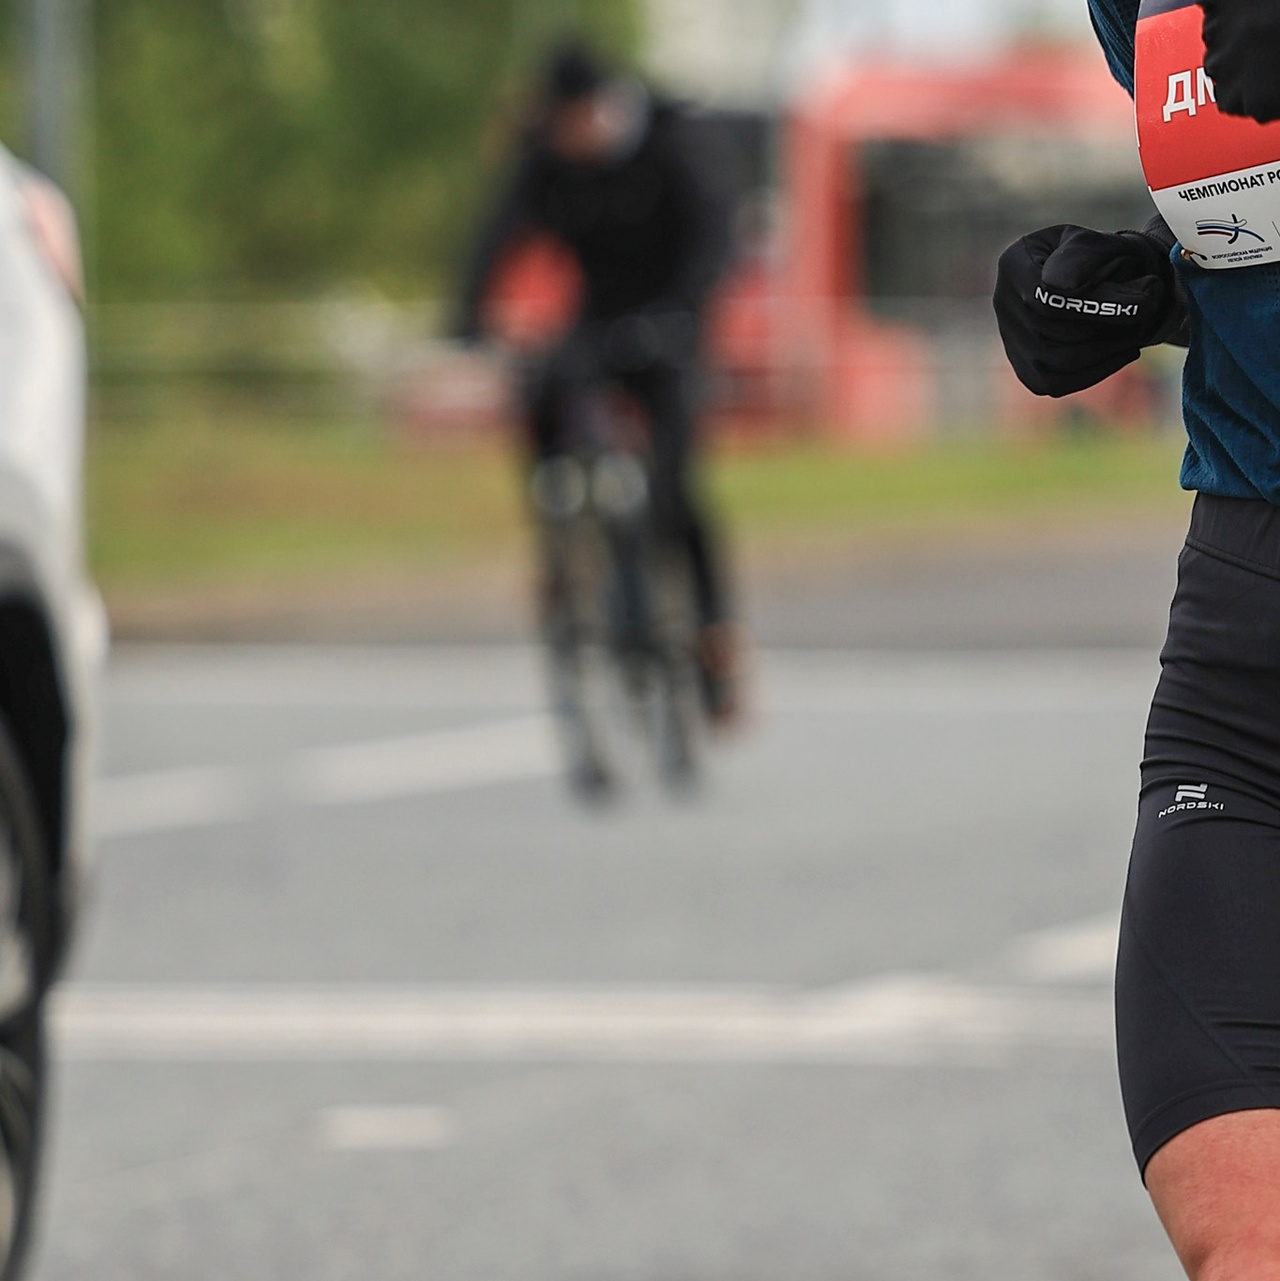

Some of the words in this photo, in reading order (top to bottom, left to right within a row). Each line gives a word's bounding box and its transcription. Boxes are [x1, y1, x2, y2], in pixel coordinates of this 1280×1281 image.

[1178, 173, 1265, 202] ЧЕМПИОНАТ
[1035, 286, 1139, 317] NORDSKI
[1158, 801, 1224, 818] NORDSKI
